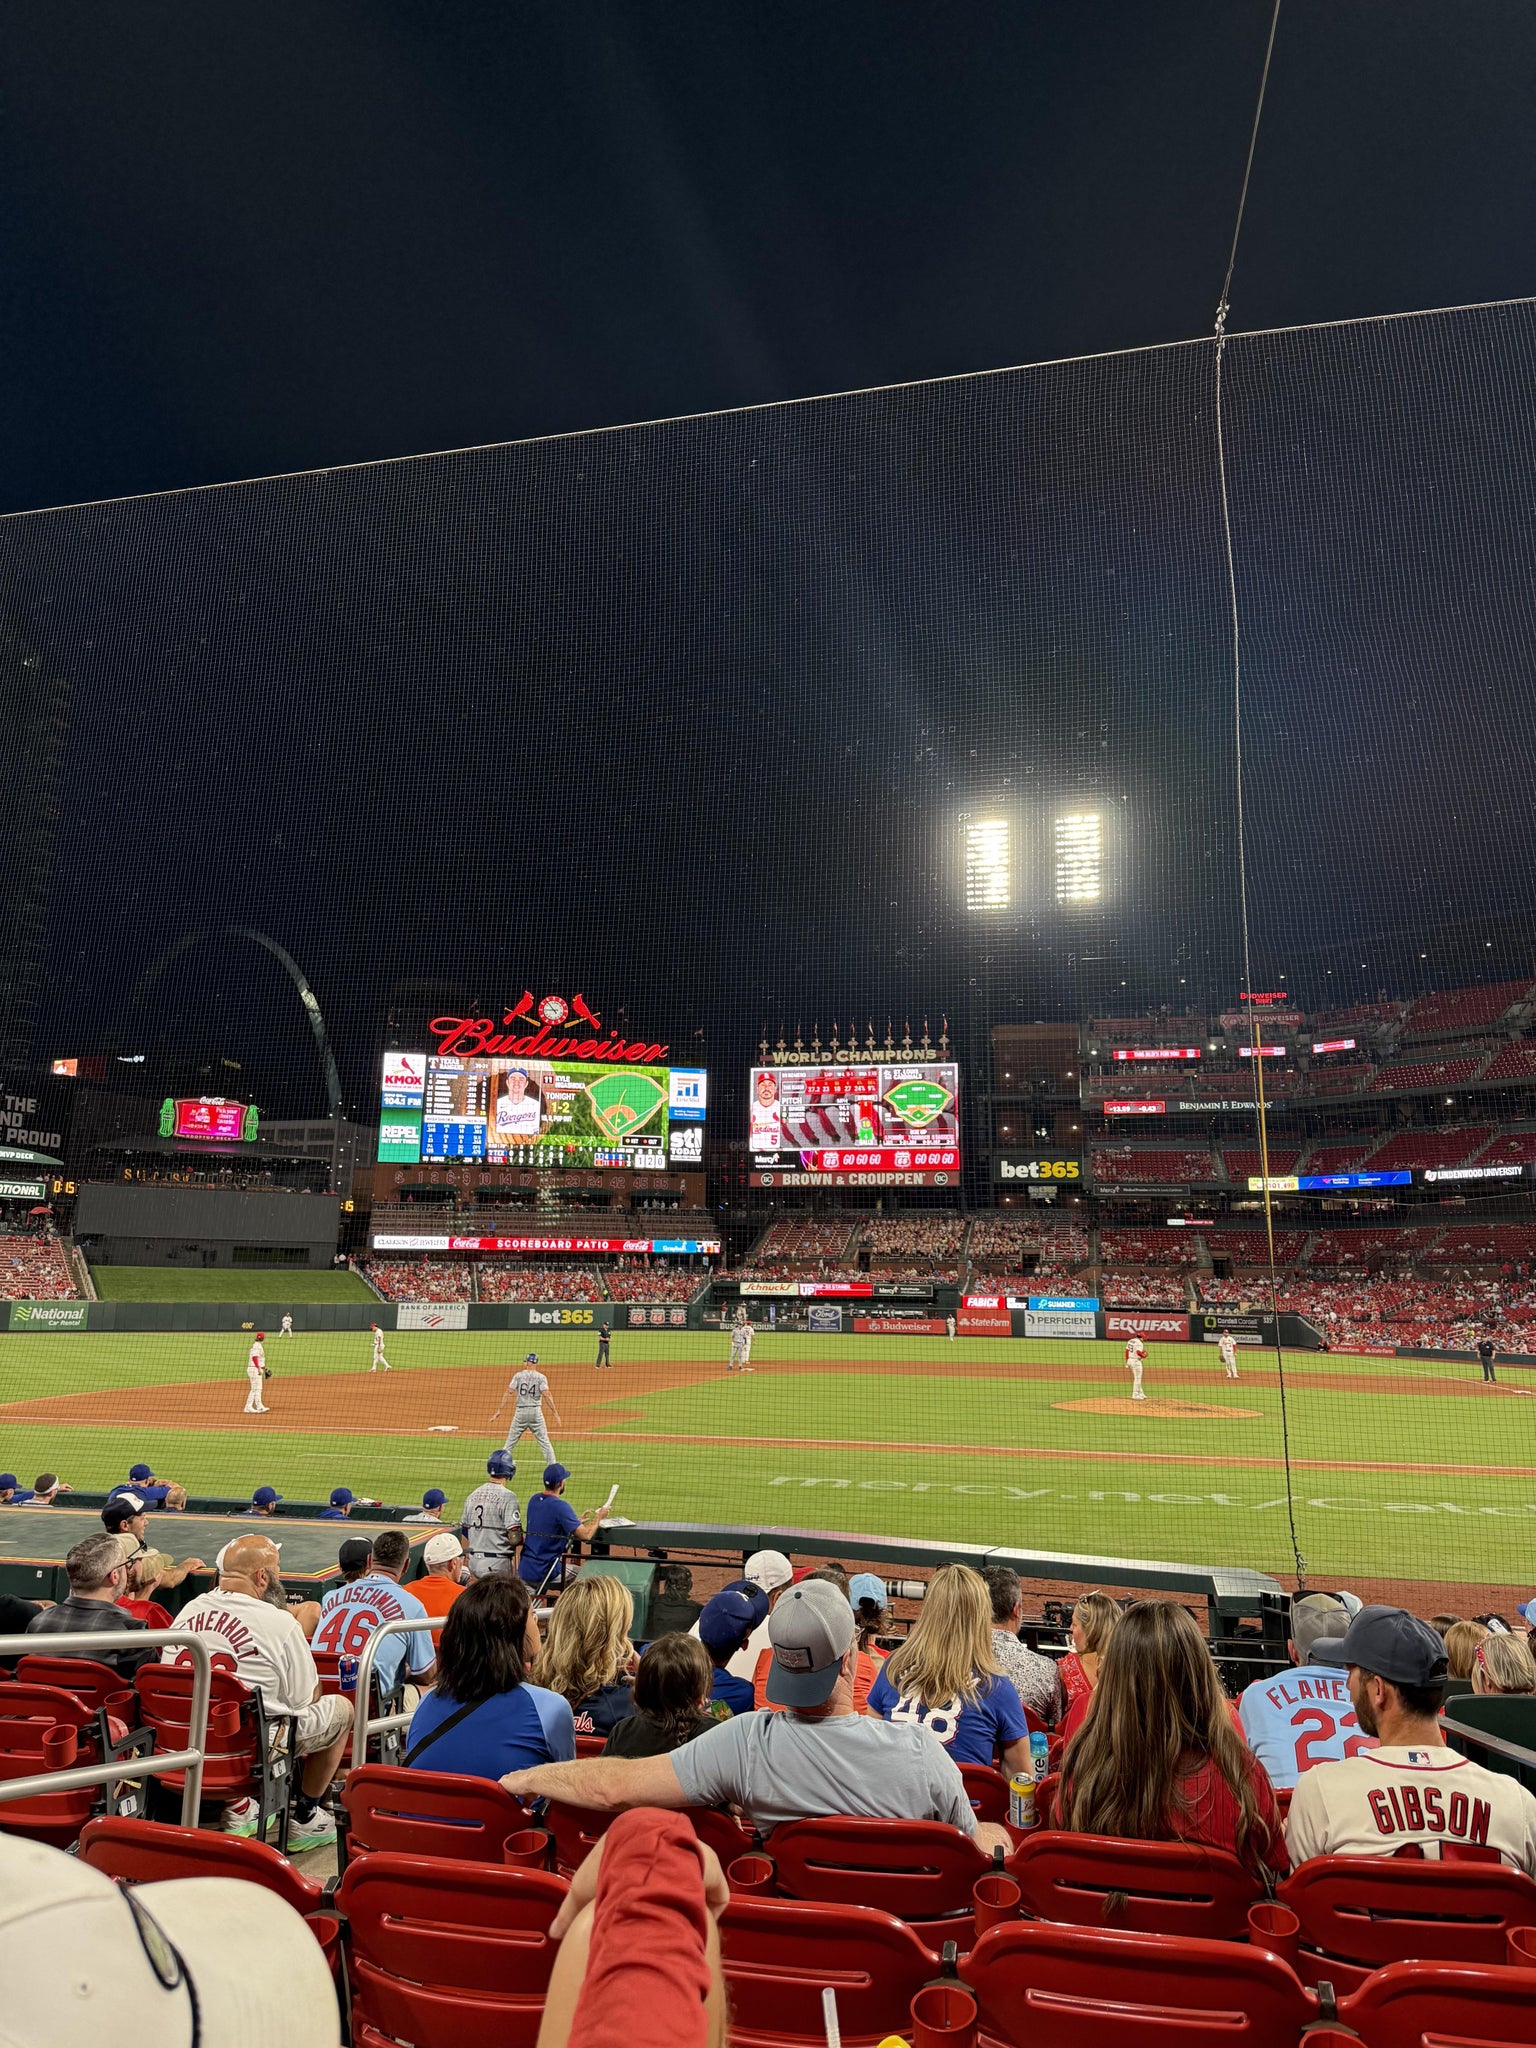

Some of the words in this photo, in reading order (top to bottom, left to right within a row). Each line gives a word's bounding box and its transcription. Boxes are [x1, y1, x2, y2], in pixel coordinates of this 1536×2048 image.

[429, 1016, 669, 1062] Budweiser
[773, 1052, 832, 1063] WORLD
[836, 1050, 937, 1062] CHAMPIONS
[385, 1075, 422, 1085] KMOX
[544, 1076, 553, 1084] 11
[546, 1092, 576, 1100] TONIGHT
[782, 1097, 802, 1105] PITCH
[5, 1095, 37, 1114] THE
[551, 1102, 570, 1113] 1-2
[1179, 1102, 1220, 1110] BENJAMIN
[6, 1128, 61, 1148] PROUD
[382, 1126, 419, 1138] REPEL
[671, 1128, 702, 1149] stl
[770, 1135, 778, 1145] 5
[16, 1152, 34, 1160] DECK
[755, 1155, 774, 1164] Mercy
[843, 1154, 853, 1165] GO
[856, 1154, 867, 1165] GO
[869, 1154, 881, 1165] GO
[915, 1154, 926, 1165] GO
[928, 1154, 940, 1165] GO
[942, 1154, 954, 1165] GO
[1001, 1161, 1079, 1178] bet365
[1438, 1170, 1483, 1180] LINDENWOOD
[1484, 1166, 1523, 1177] UNIVERSITY
[430, 1173, 439, 1184] 2
[479, 1173, 491, 1185] 10
[500, 1174, 512, 1186] 14
[520, 1174, 532, 1186] 17
[565, 1175, 580, 1188] 23
[587, 1176, 603, 1189] 24
[610, 1177, 626, 1189] 42
[633, 1178, 648, 1190] 45
[653, 1178, 669, 1190] 85
[783, 1173, 832, 1185] BROWN
[849, 1173, 924, 1185] CROUPPEN
[53, 1181, 75, 1194] 0:15
[452, 1237, 480, 1249] Coca-Cola
[497, 1239, 572, 1249] SCOREBOARD
[576, 1240, 609, 1249] PATIO
[623, 1240, 649, 1251] Coca-Cola
[800, 1285, 815, 1295] UP
[967, 1297, 999, 1308] FABICK
[30, 1303, 83, 1320] National
[529, 1309, 593, 1324] bet365
[815, 1309, 835, 1318] Ford
[882, 1322, 932, 1331] Budweiser
[1038, 1317, 1093, 1325] PERFICIENT
[1108, 1318, 1183, 1334] EQUIFAX
[519, 1383, 536, 1397] 64
[768, 1476, 1536, 1518] mercy.net/Catc
[473, 1505, 485, 1528] 3
[174, 1610, 259, 1660] THERHOLT
[318, 1608, 379, 1656] 46
[1265, 1680, 1353, 1710] FLAHE
[1291, 1708, 1380, 1773] 22
[1367, 1786, 1491, 1846] GIBSON
